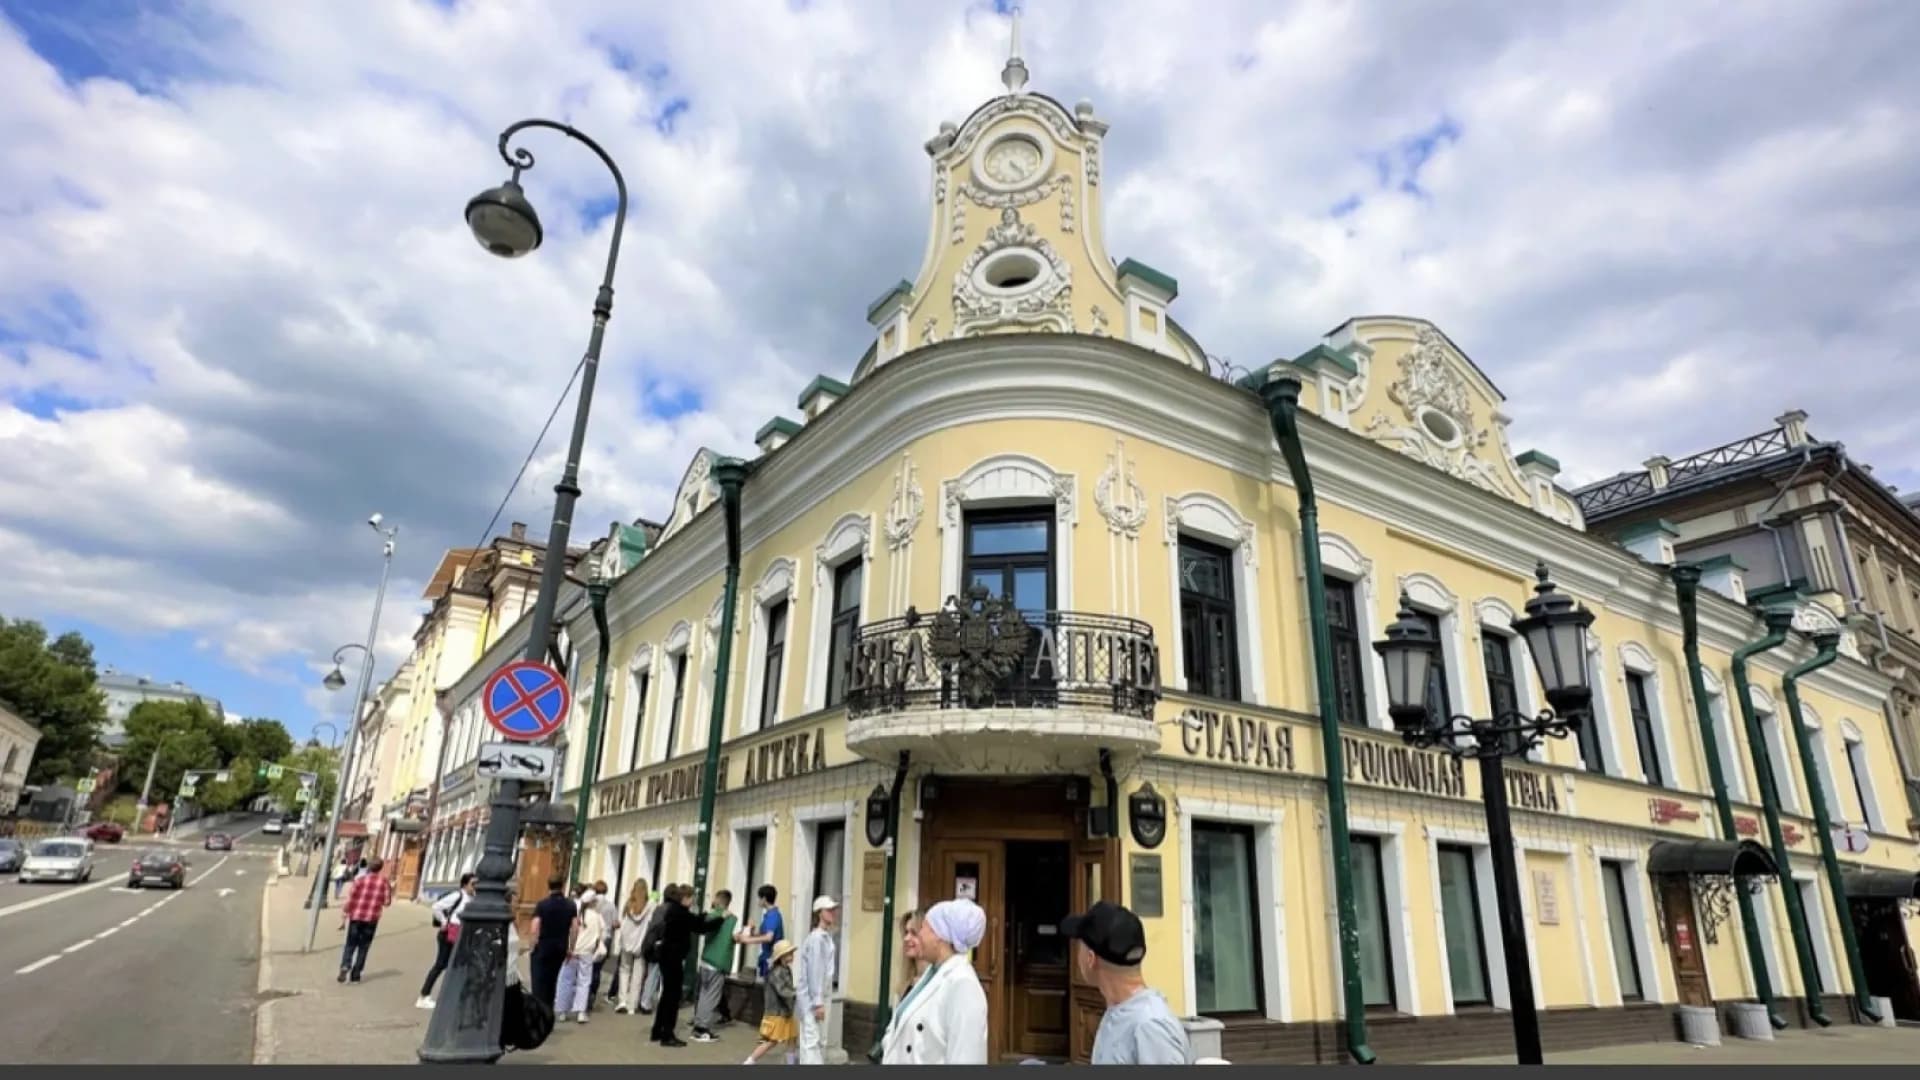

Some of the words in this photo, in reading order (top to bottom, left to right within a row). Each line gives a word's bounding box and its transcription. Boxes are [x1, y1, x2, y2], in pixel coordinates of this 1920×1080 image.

[744, 728, 826, 786] АПТЕКА
[1181, 708, 1295, 770] СТАРАЯ
[1343, 736, 1466, 798] РОЛОМНАЯ
[1503, 767, 1559, 811] ТЕКА
